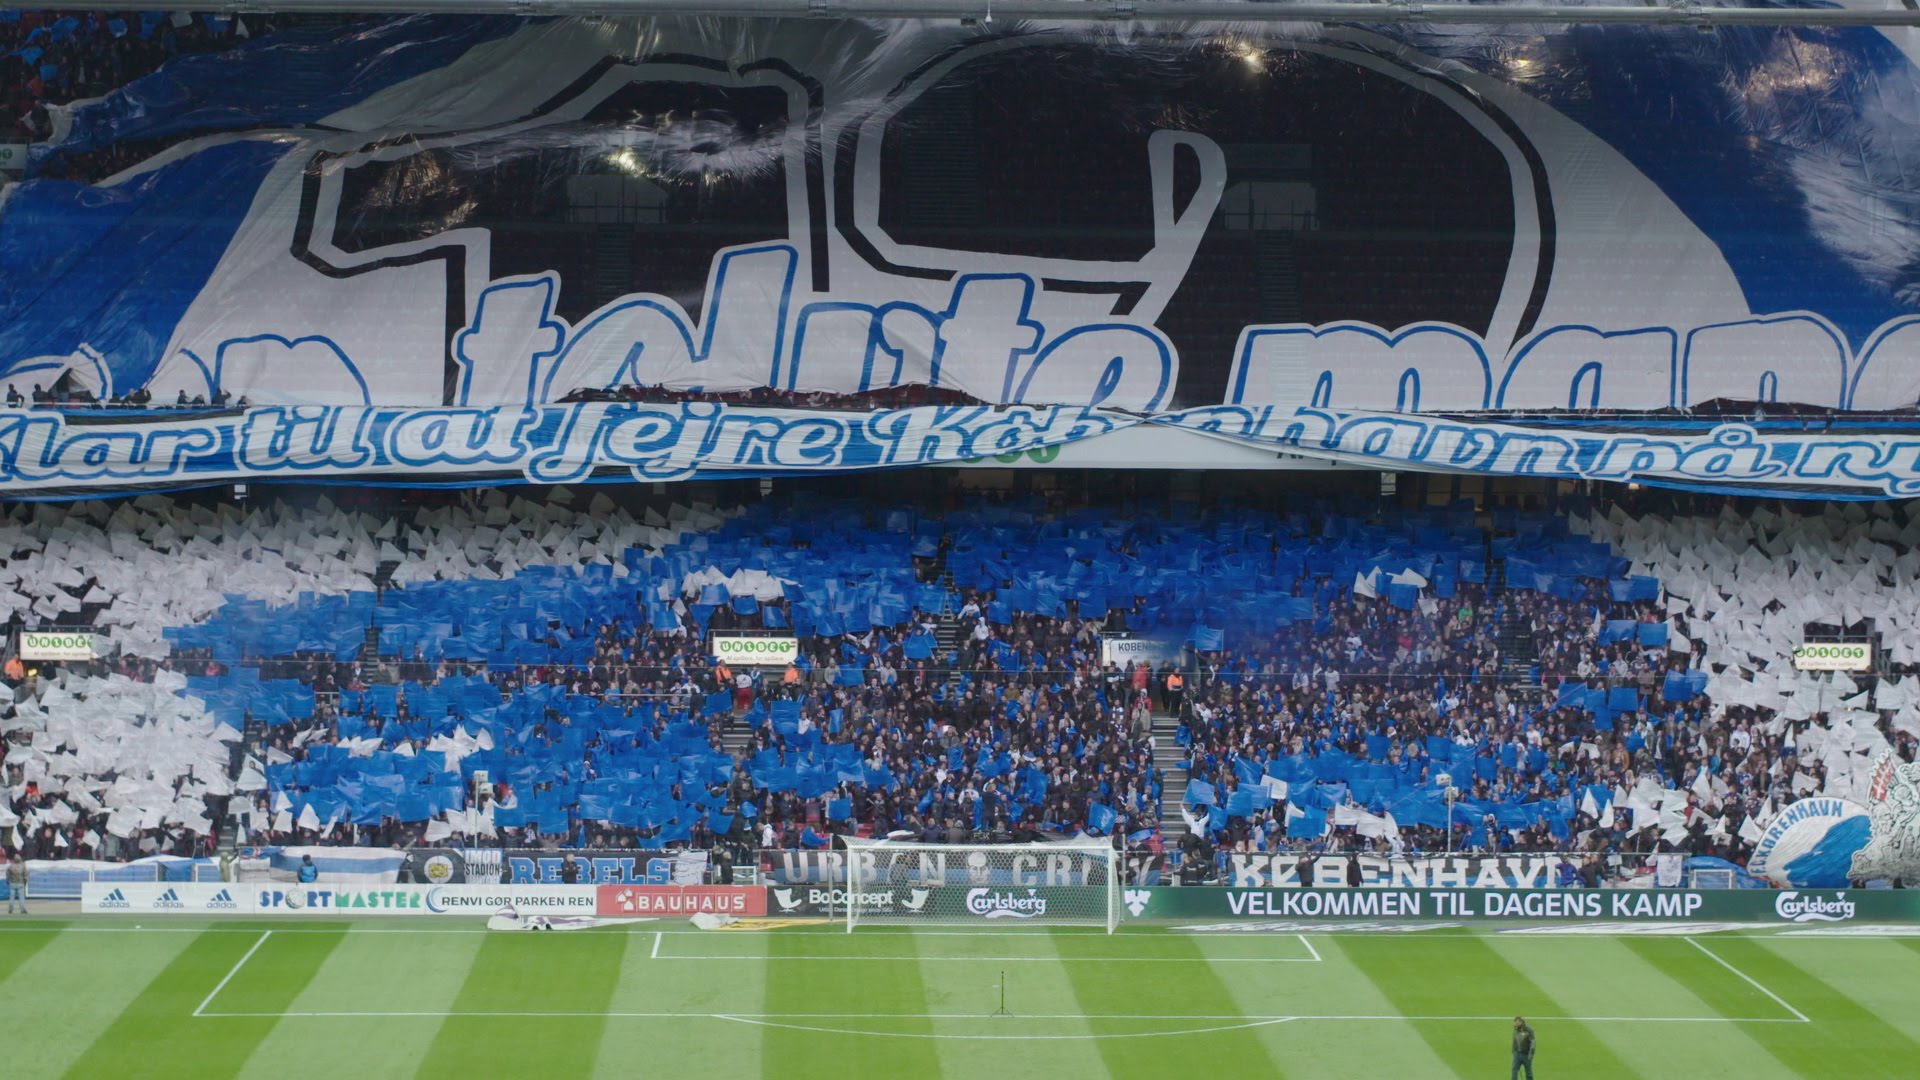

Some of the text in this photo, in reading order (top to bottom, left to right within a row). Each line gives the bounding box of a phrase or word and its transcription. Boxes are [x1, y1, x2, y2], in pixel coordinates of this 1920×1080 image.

[240, 407, 374, 471] til
[396, 404, 536, 466] at
[1588, 425, 1792, 478] på
[721, 641, 790, 652] UNIBET
[465, 863, 500, 876] STADION
[508, 857, 672, 885] REBELS
[99, 900, 131, 909] adidas
[153, 900, 185, 909] adidas
[206, 900, 238, 909] adidas
[258, 890, 421, 909] SPORTMASTER
[485, 896, 511, 908] GØR
[515, 896, 565, 908] PARKEN
[568, 896, 594, 907] REN
[638, 892, 745, 911] BAUHAUS
[809, 889, 893, 907] BoConcept
[966, 888, 1047, 916] Carlsberg
[1227, 891, 1702, 917] VELKOMMEN TIL DAGENS KAMP
[1775, 892, 1855, 920] Carlsberg
